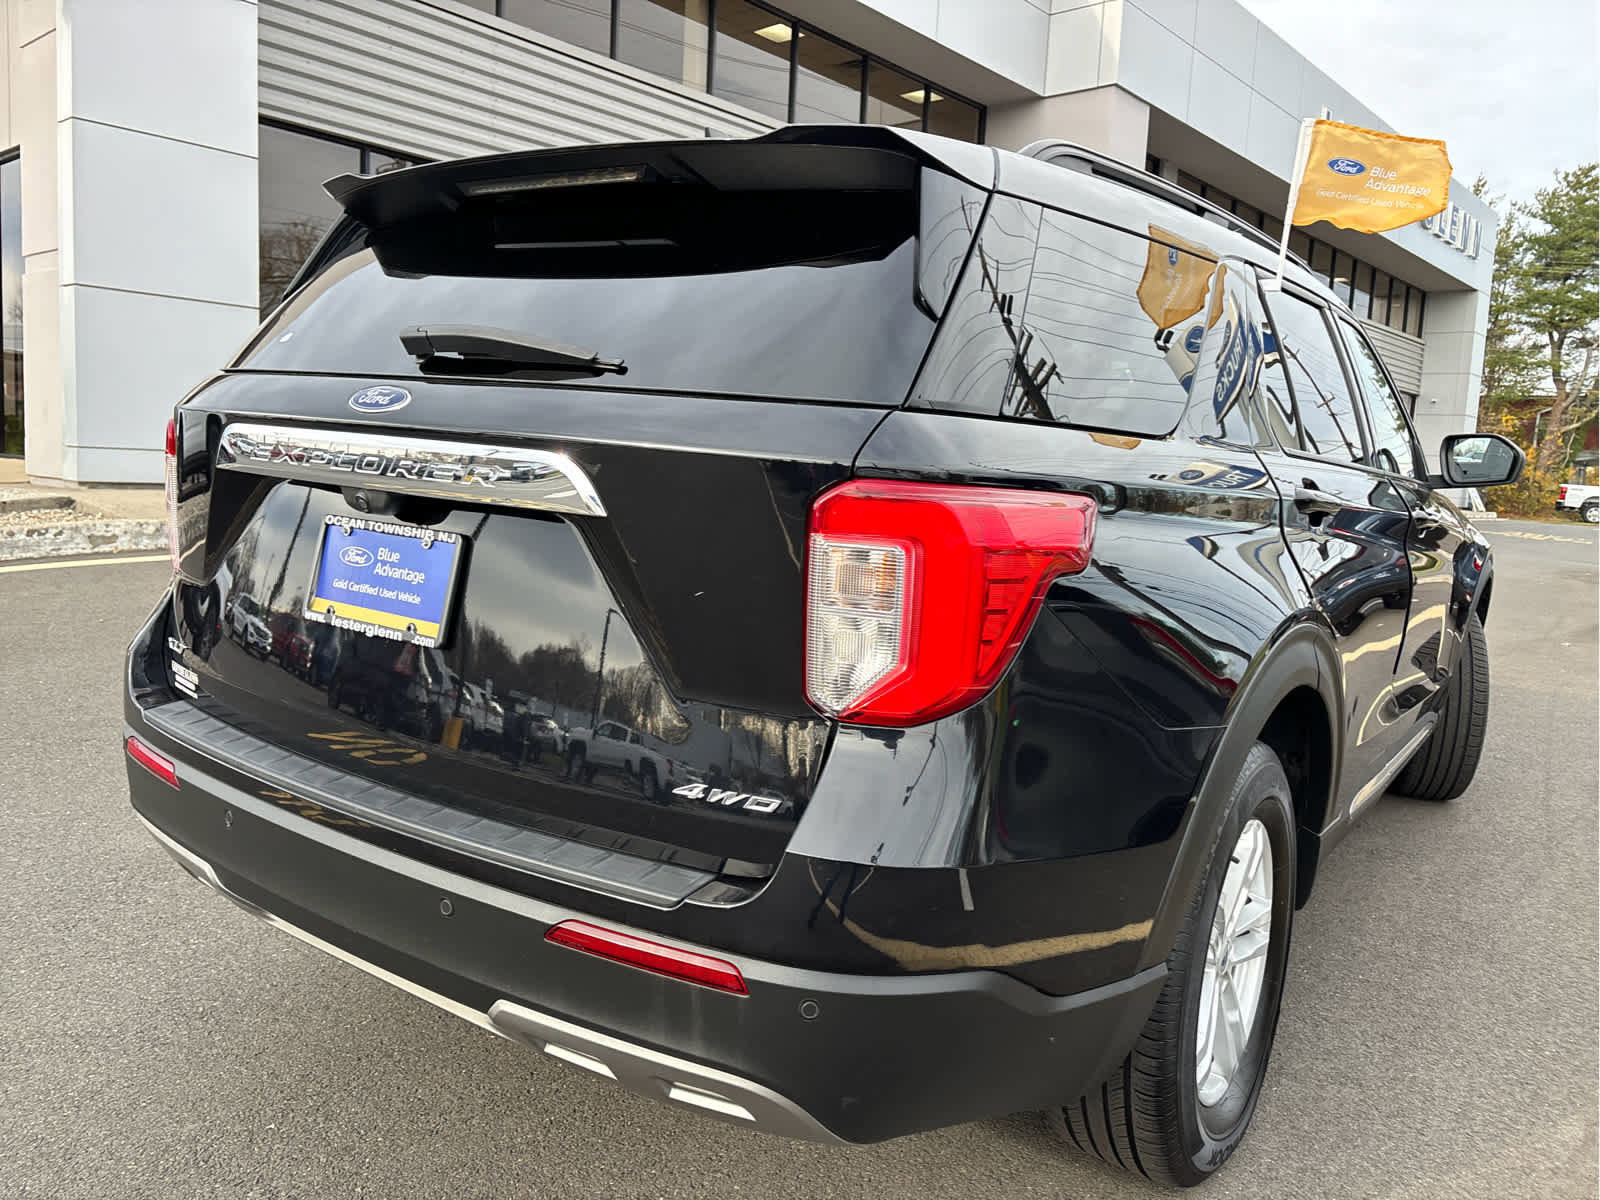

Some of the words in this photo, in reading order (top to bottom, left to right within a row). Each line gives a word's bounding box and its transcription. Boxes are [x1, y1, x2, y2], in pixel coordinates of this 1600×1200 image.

[1331, 158, 1363, 174] Ford
[1370, 166, 1397, 180] Blue
[1365, 178, 1431, 197] Advantage
[354, 386, 398, 408] Ford
[250, 444, 500, 488] EXPLORER
[325, 515, 365, 529] OCEAN
[368, 521, 434, 541] TOWNSHIP
[437, 533, 457, 543] NJ
[377, 547, 400, 563] Blue
[373, 562, 425, 585] Advantage
[333, 578, 348, 589] Gold
[348, 581, 378, 596] Certified
[379, 587, 398, 600] Used
[398, 591, 421, 605] Vehicle
[304, 611, 326, 623] www.
[331, 616, 403, 642] lesterglenn
[411, 634, 435, 648] .com
[672, 783, 783, 813] 4WD
